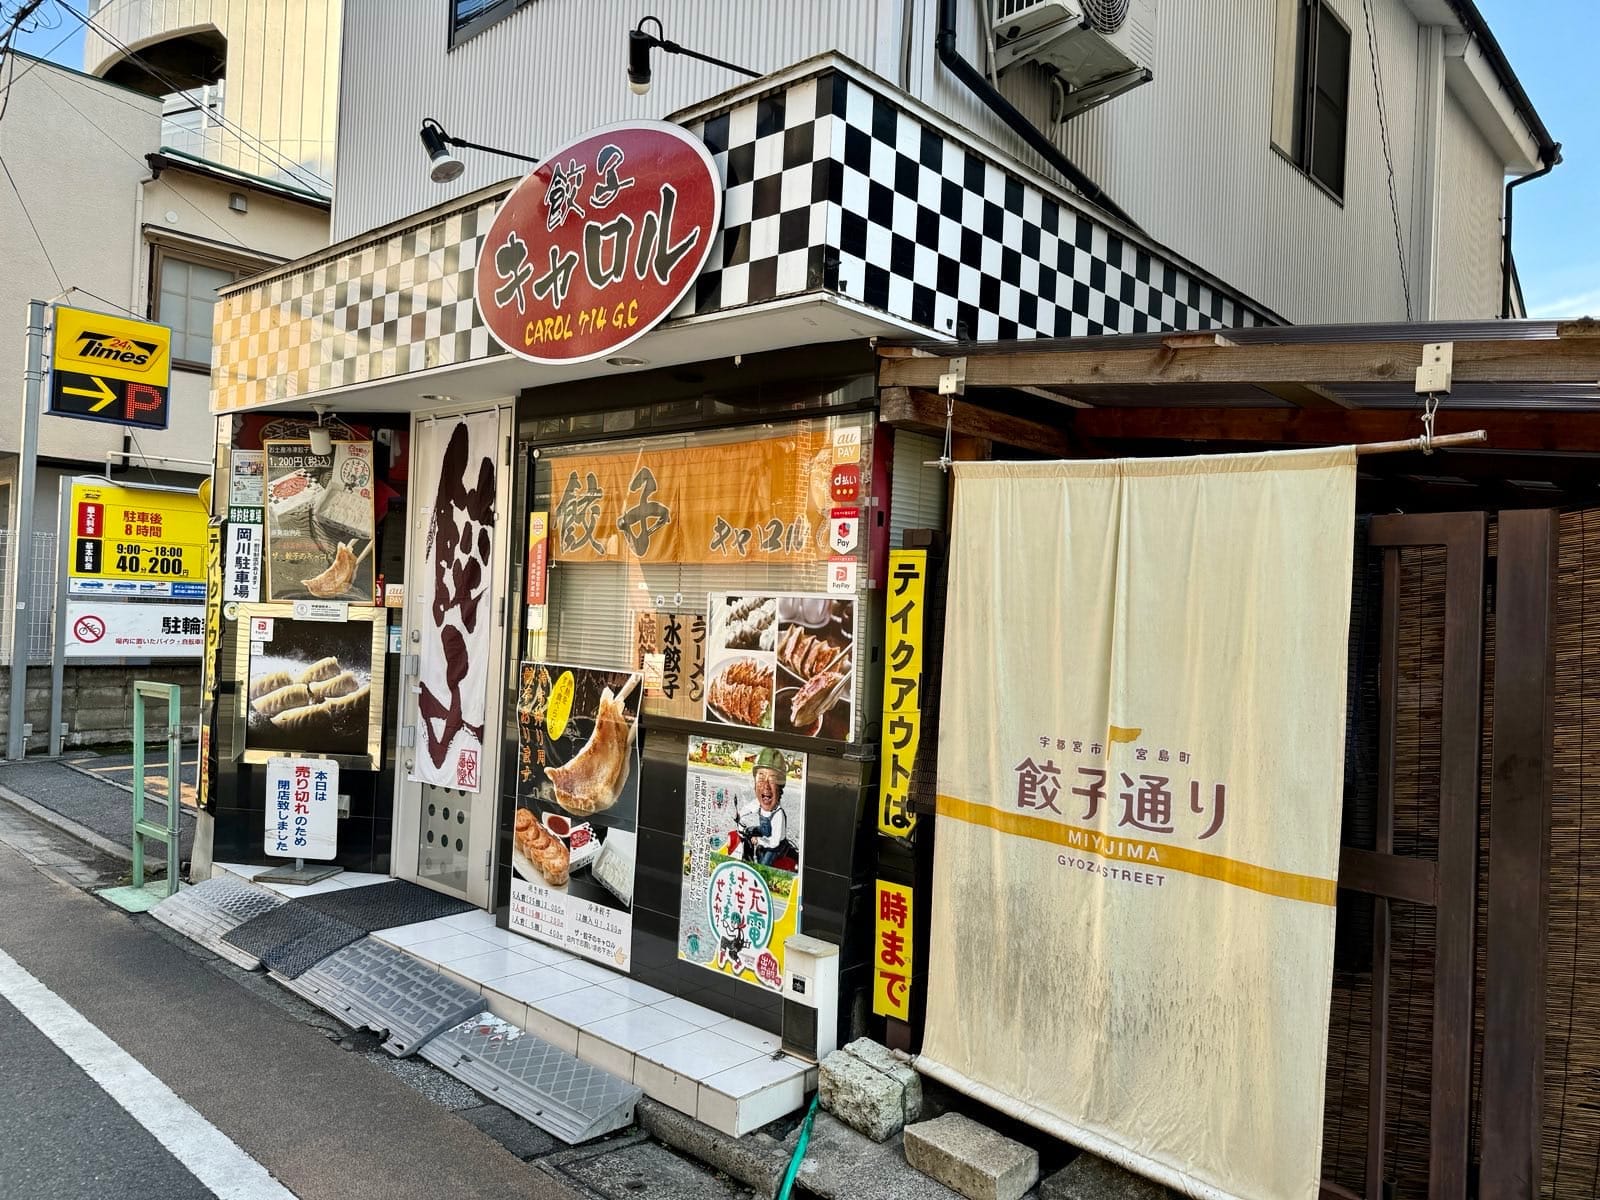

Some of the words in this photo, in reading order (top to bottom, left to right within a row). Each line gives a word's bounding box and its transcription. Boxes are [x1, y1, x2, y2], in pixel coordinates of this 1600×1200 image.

[544, 143, 635, 232] 餃子
[495, 182, 701, 315] キャロル
[78, 339, 148, 365] Times
[524, 313, 573, 346] CAROL
[126, 383, 162, 420] P
[837, 447, 856, 458] PAY
[123, 510, 163, 525] 駐車後
[556, 465, 671, 558] 餃子
[837, 537, 850, 548] Pay
[233, 527, 252, 599] 岡川駐車場
[662, 615, 682, 699] 水餃子
[885, 563, 920, 831] テイクアウトは
[1039, 736, 1104, 755] 宇都宮市
[1135, 748, 1191, 765] 宮島町
[276, 780, 290, 852] 閉店致しました
[294, 765, 311, 847] 売り切れのため
[314, 770, 328, 802] 本日は
[1015, 757, 1226, 840] 餃子通り
[1102, 866, 1166, 887] STREET
[746, 880, 768, 949] 充電
[880, 891, 908, 1008] 時まで
